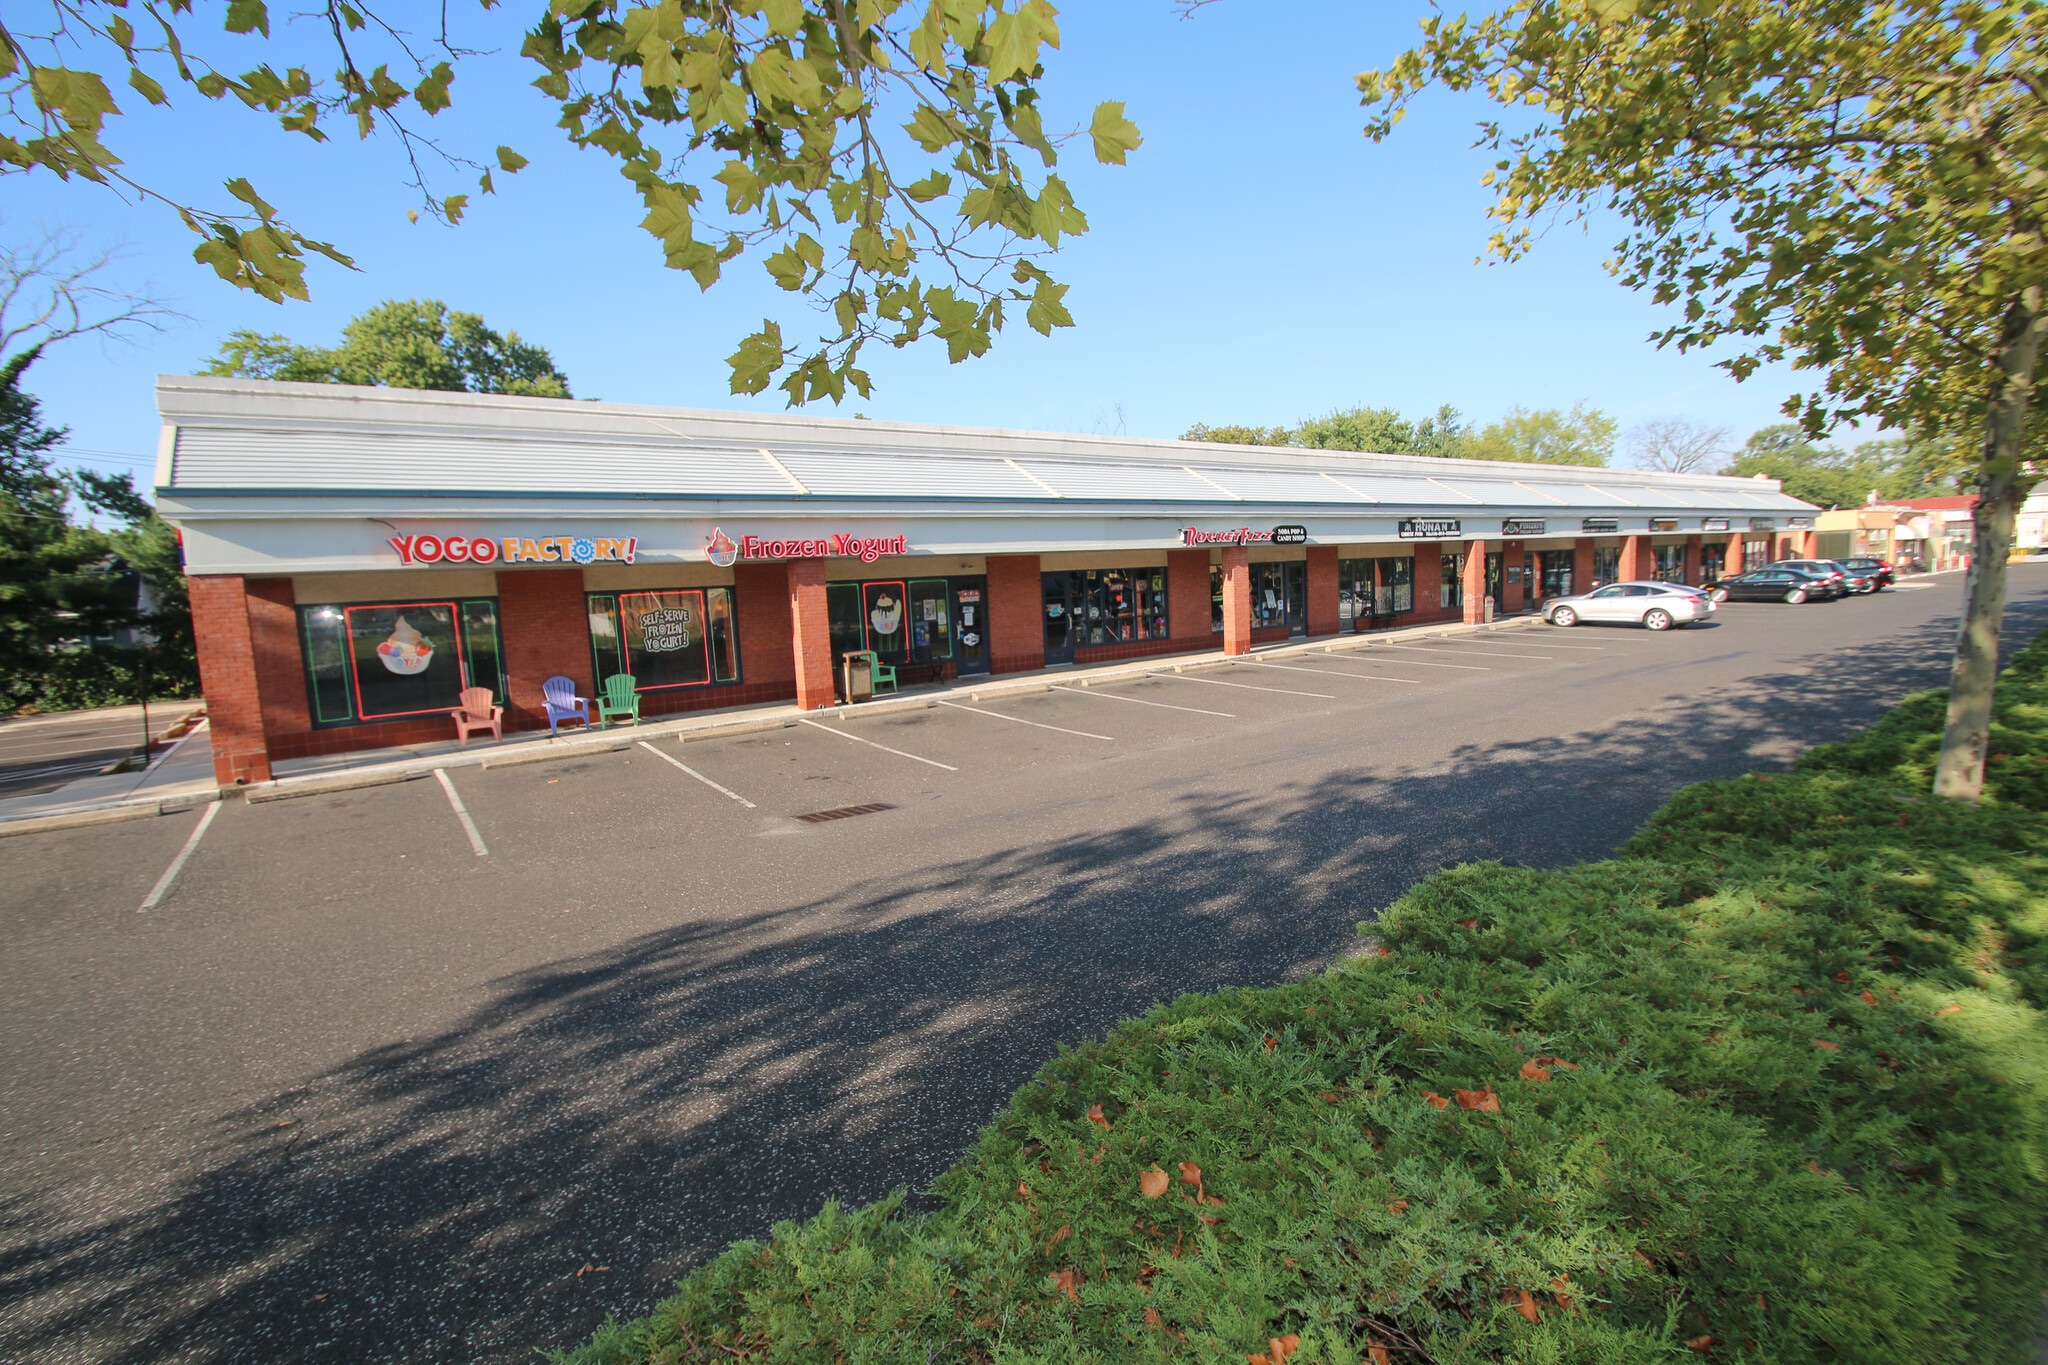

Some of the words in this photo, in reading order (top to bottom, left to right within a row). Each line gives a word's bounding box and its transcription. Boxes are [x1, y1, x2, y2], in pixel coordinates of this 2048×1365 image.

[1415, 522, 1448, 532] HUNAN
[389, 534, 498, 565] YOGO
[501, 536, 638, 564] FACTORY!
[741, 534, 831, 559] Frozen
[830, 533, 908, 563] Yogurt
[642, 609, 689, 626] SELF-SERVE
[648, 622, 683, 638] FROZEN
[646, 632, 687, 650] YOGURT!
